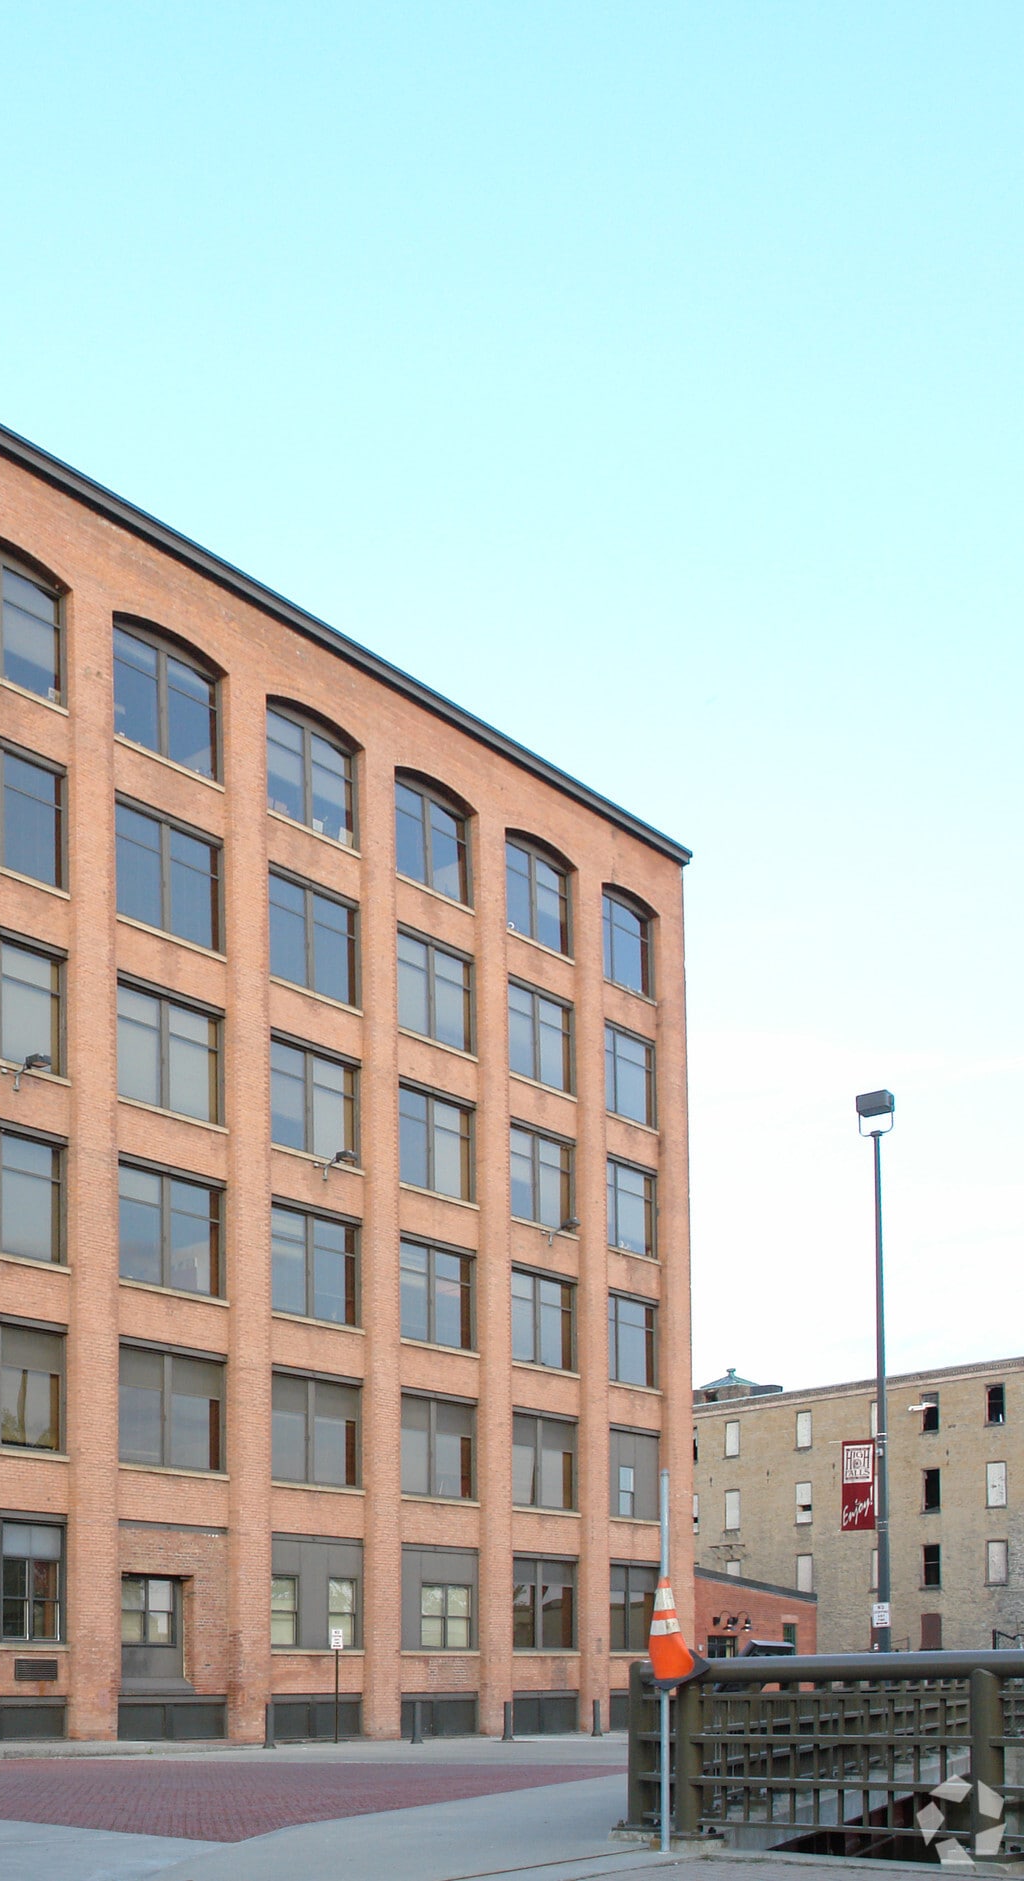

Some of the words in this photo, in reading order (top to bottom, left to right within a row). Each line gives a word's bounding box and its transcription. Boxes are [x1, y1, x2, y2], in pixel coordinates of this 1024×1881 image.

[846, 1447, 870, 1470] HIGH
[845, 1467, 871, 1478] FALLS
[842, 1485, 873, 1527] Enjoy!
